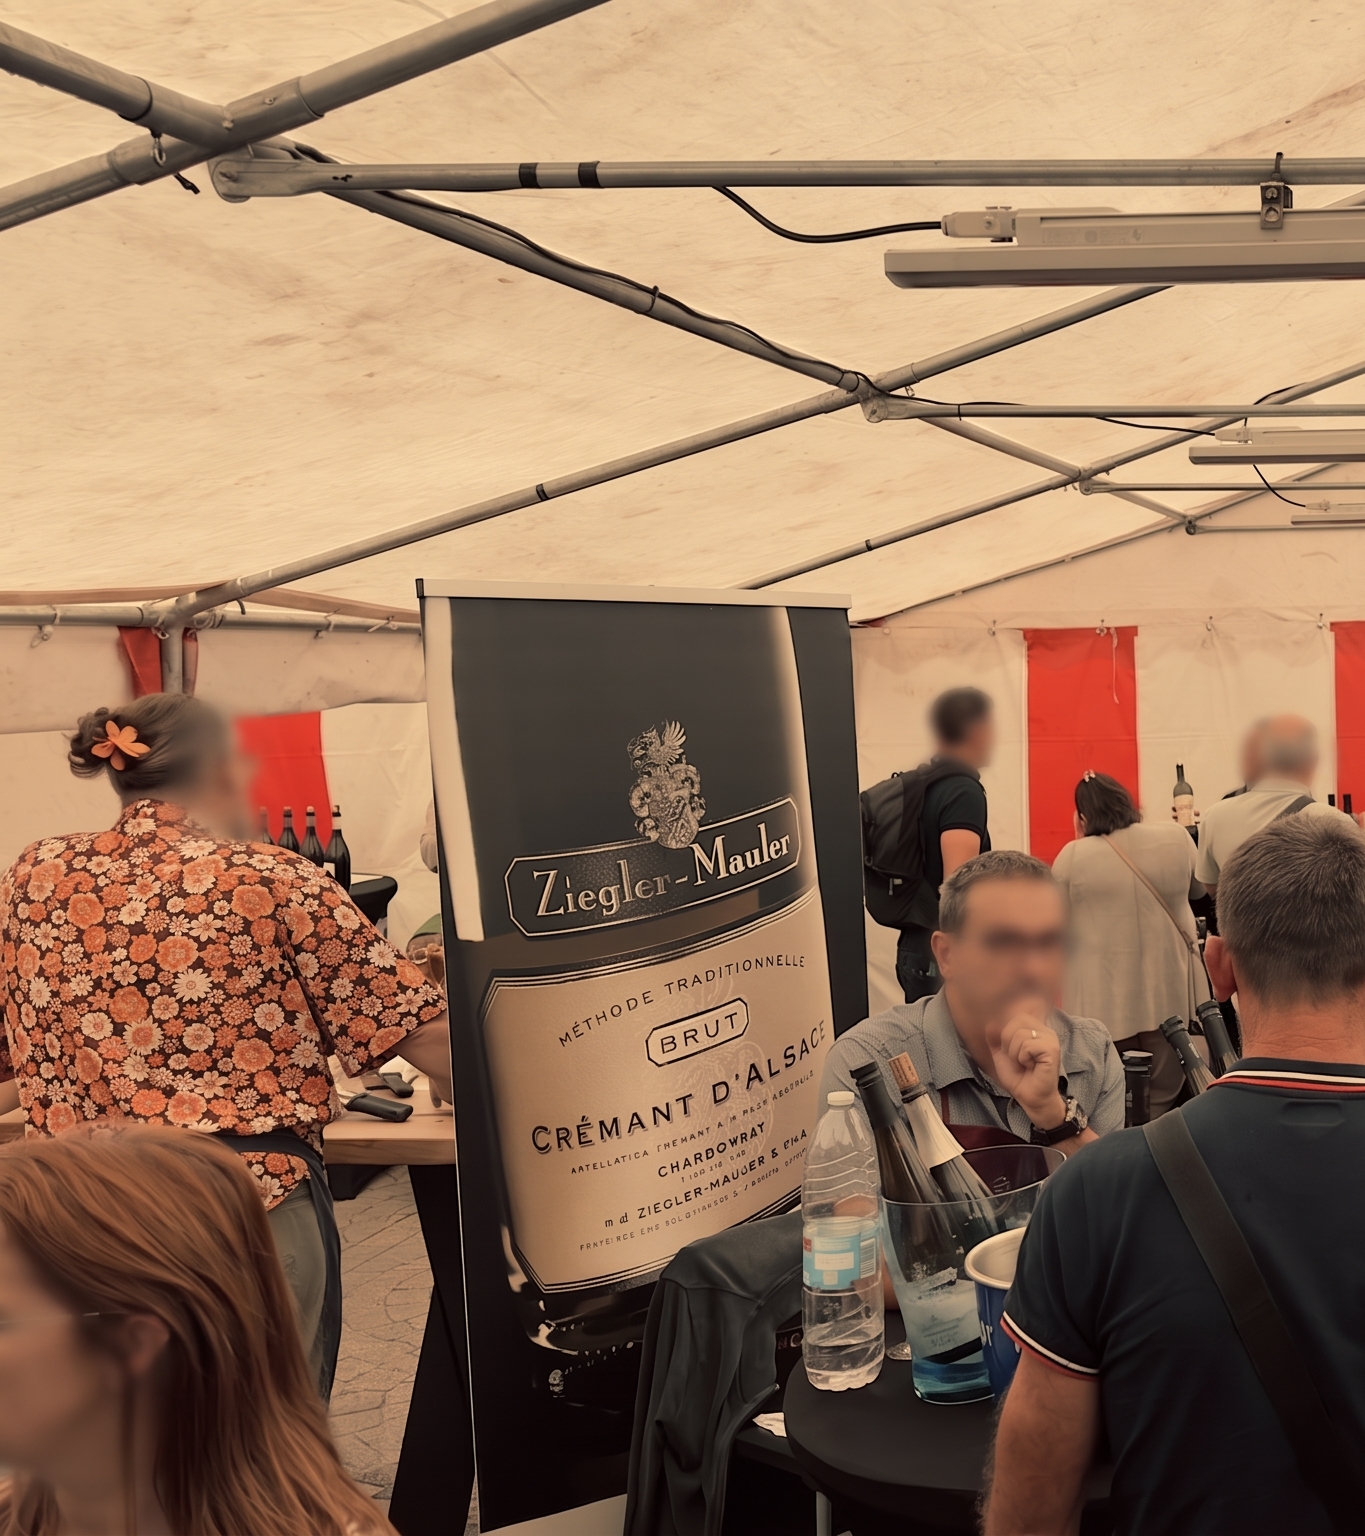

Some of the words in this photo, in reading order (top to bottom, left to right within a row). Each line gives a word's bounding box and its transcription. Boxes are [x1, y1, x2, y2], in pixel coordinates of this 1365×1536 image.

[532, 822, 790, 917] Ziegler-Mauler
[558, 990, 654, 1048] MÉTHODE
[664, 953, 806, 995] TRADITIONNELLE
[659, 1011, 739, 1055] BRUT
[531, 1093, 694, 1154] CRÉMANT
[711, 1018, 827, 1105] D'ALSACE
